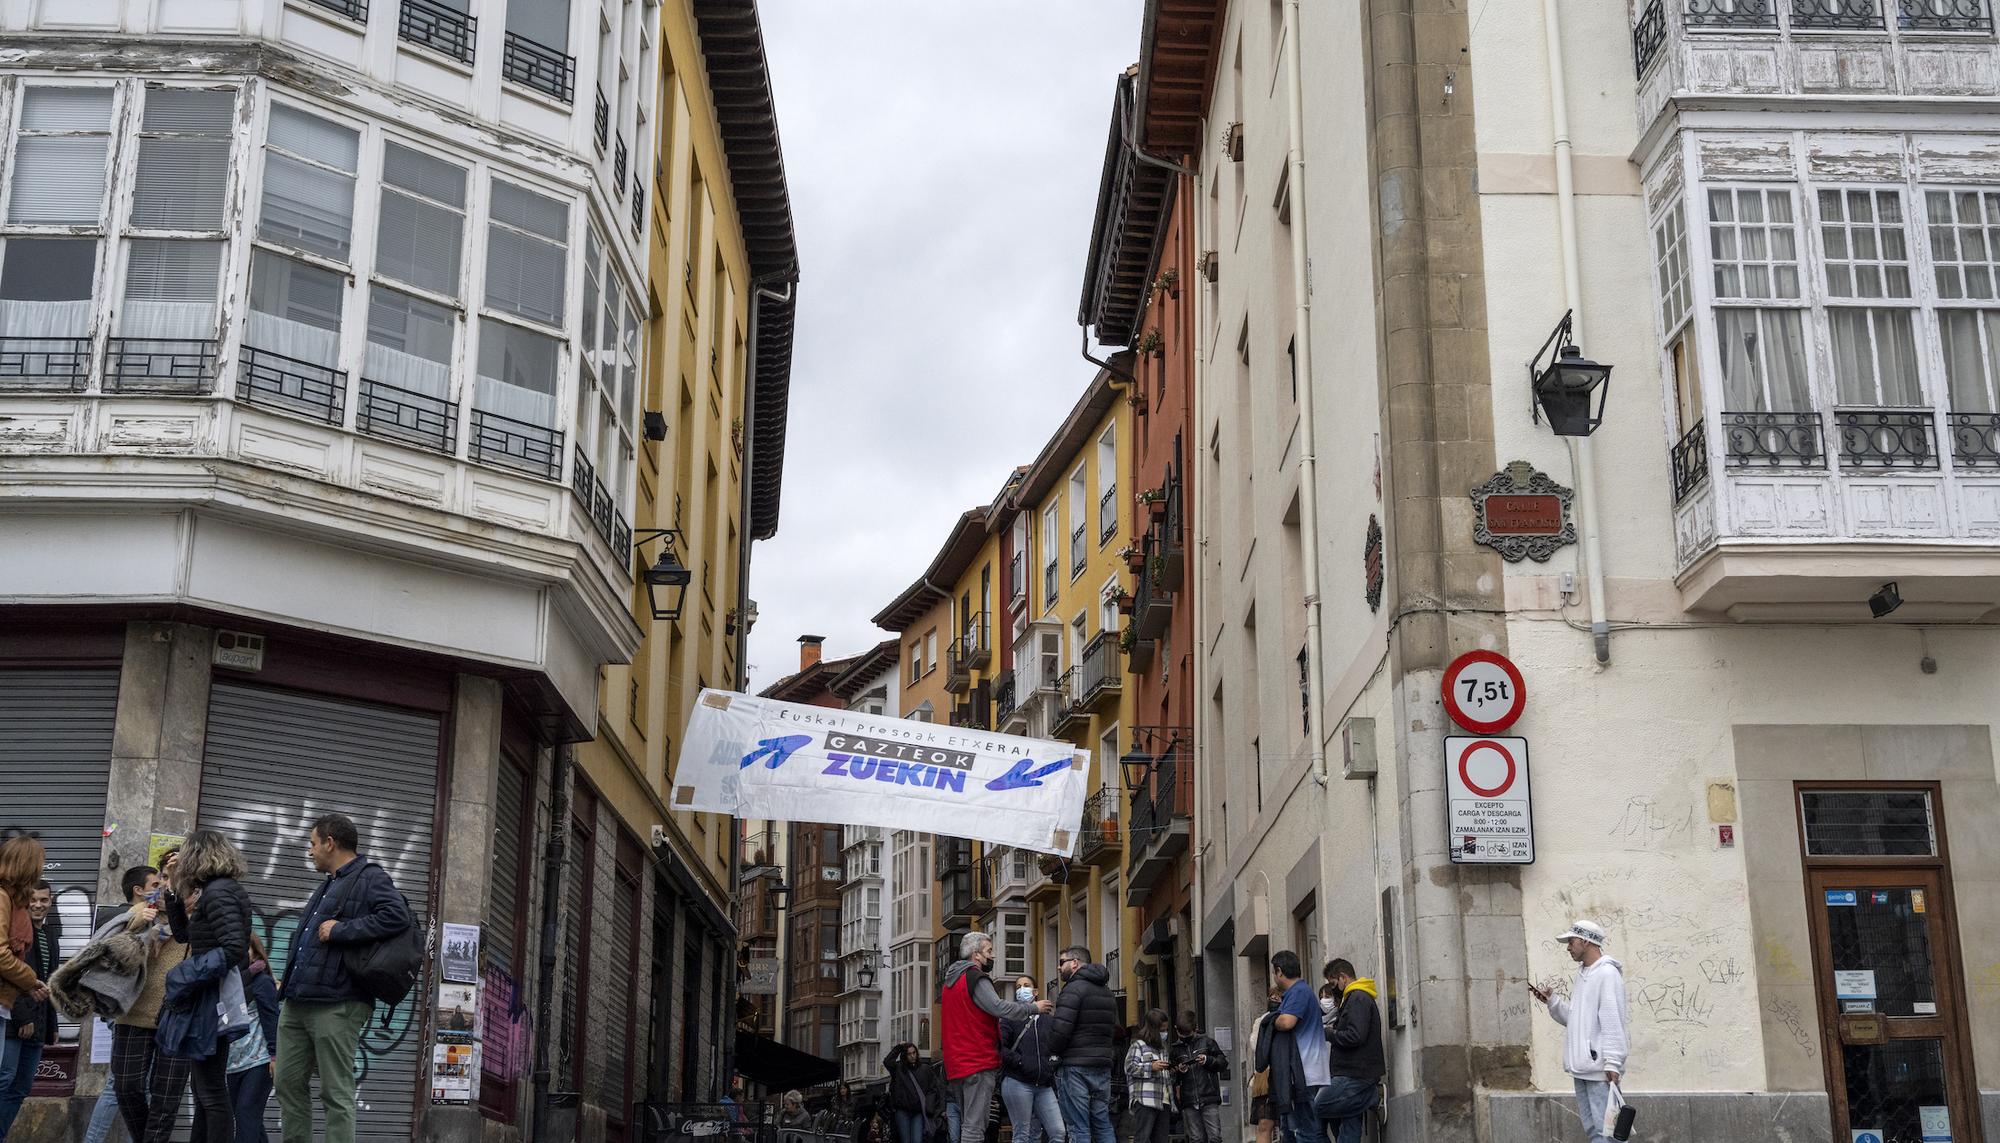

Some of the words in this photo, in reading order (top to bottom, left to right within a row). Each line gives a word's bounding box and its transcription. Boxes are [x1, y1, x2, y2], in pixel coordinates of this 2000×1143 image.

[1461, 679, 1509, 707] 7,5t
[780, 709, 845, 727] Euskal
[857, 723, 935, 743] presoak
[948, 736, 1031, 756] ETXERAI
[830, 736, 970, 767] GAZTEOK
[821, 752, 967, 793] ZUEKIN
